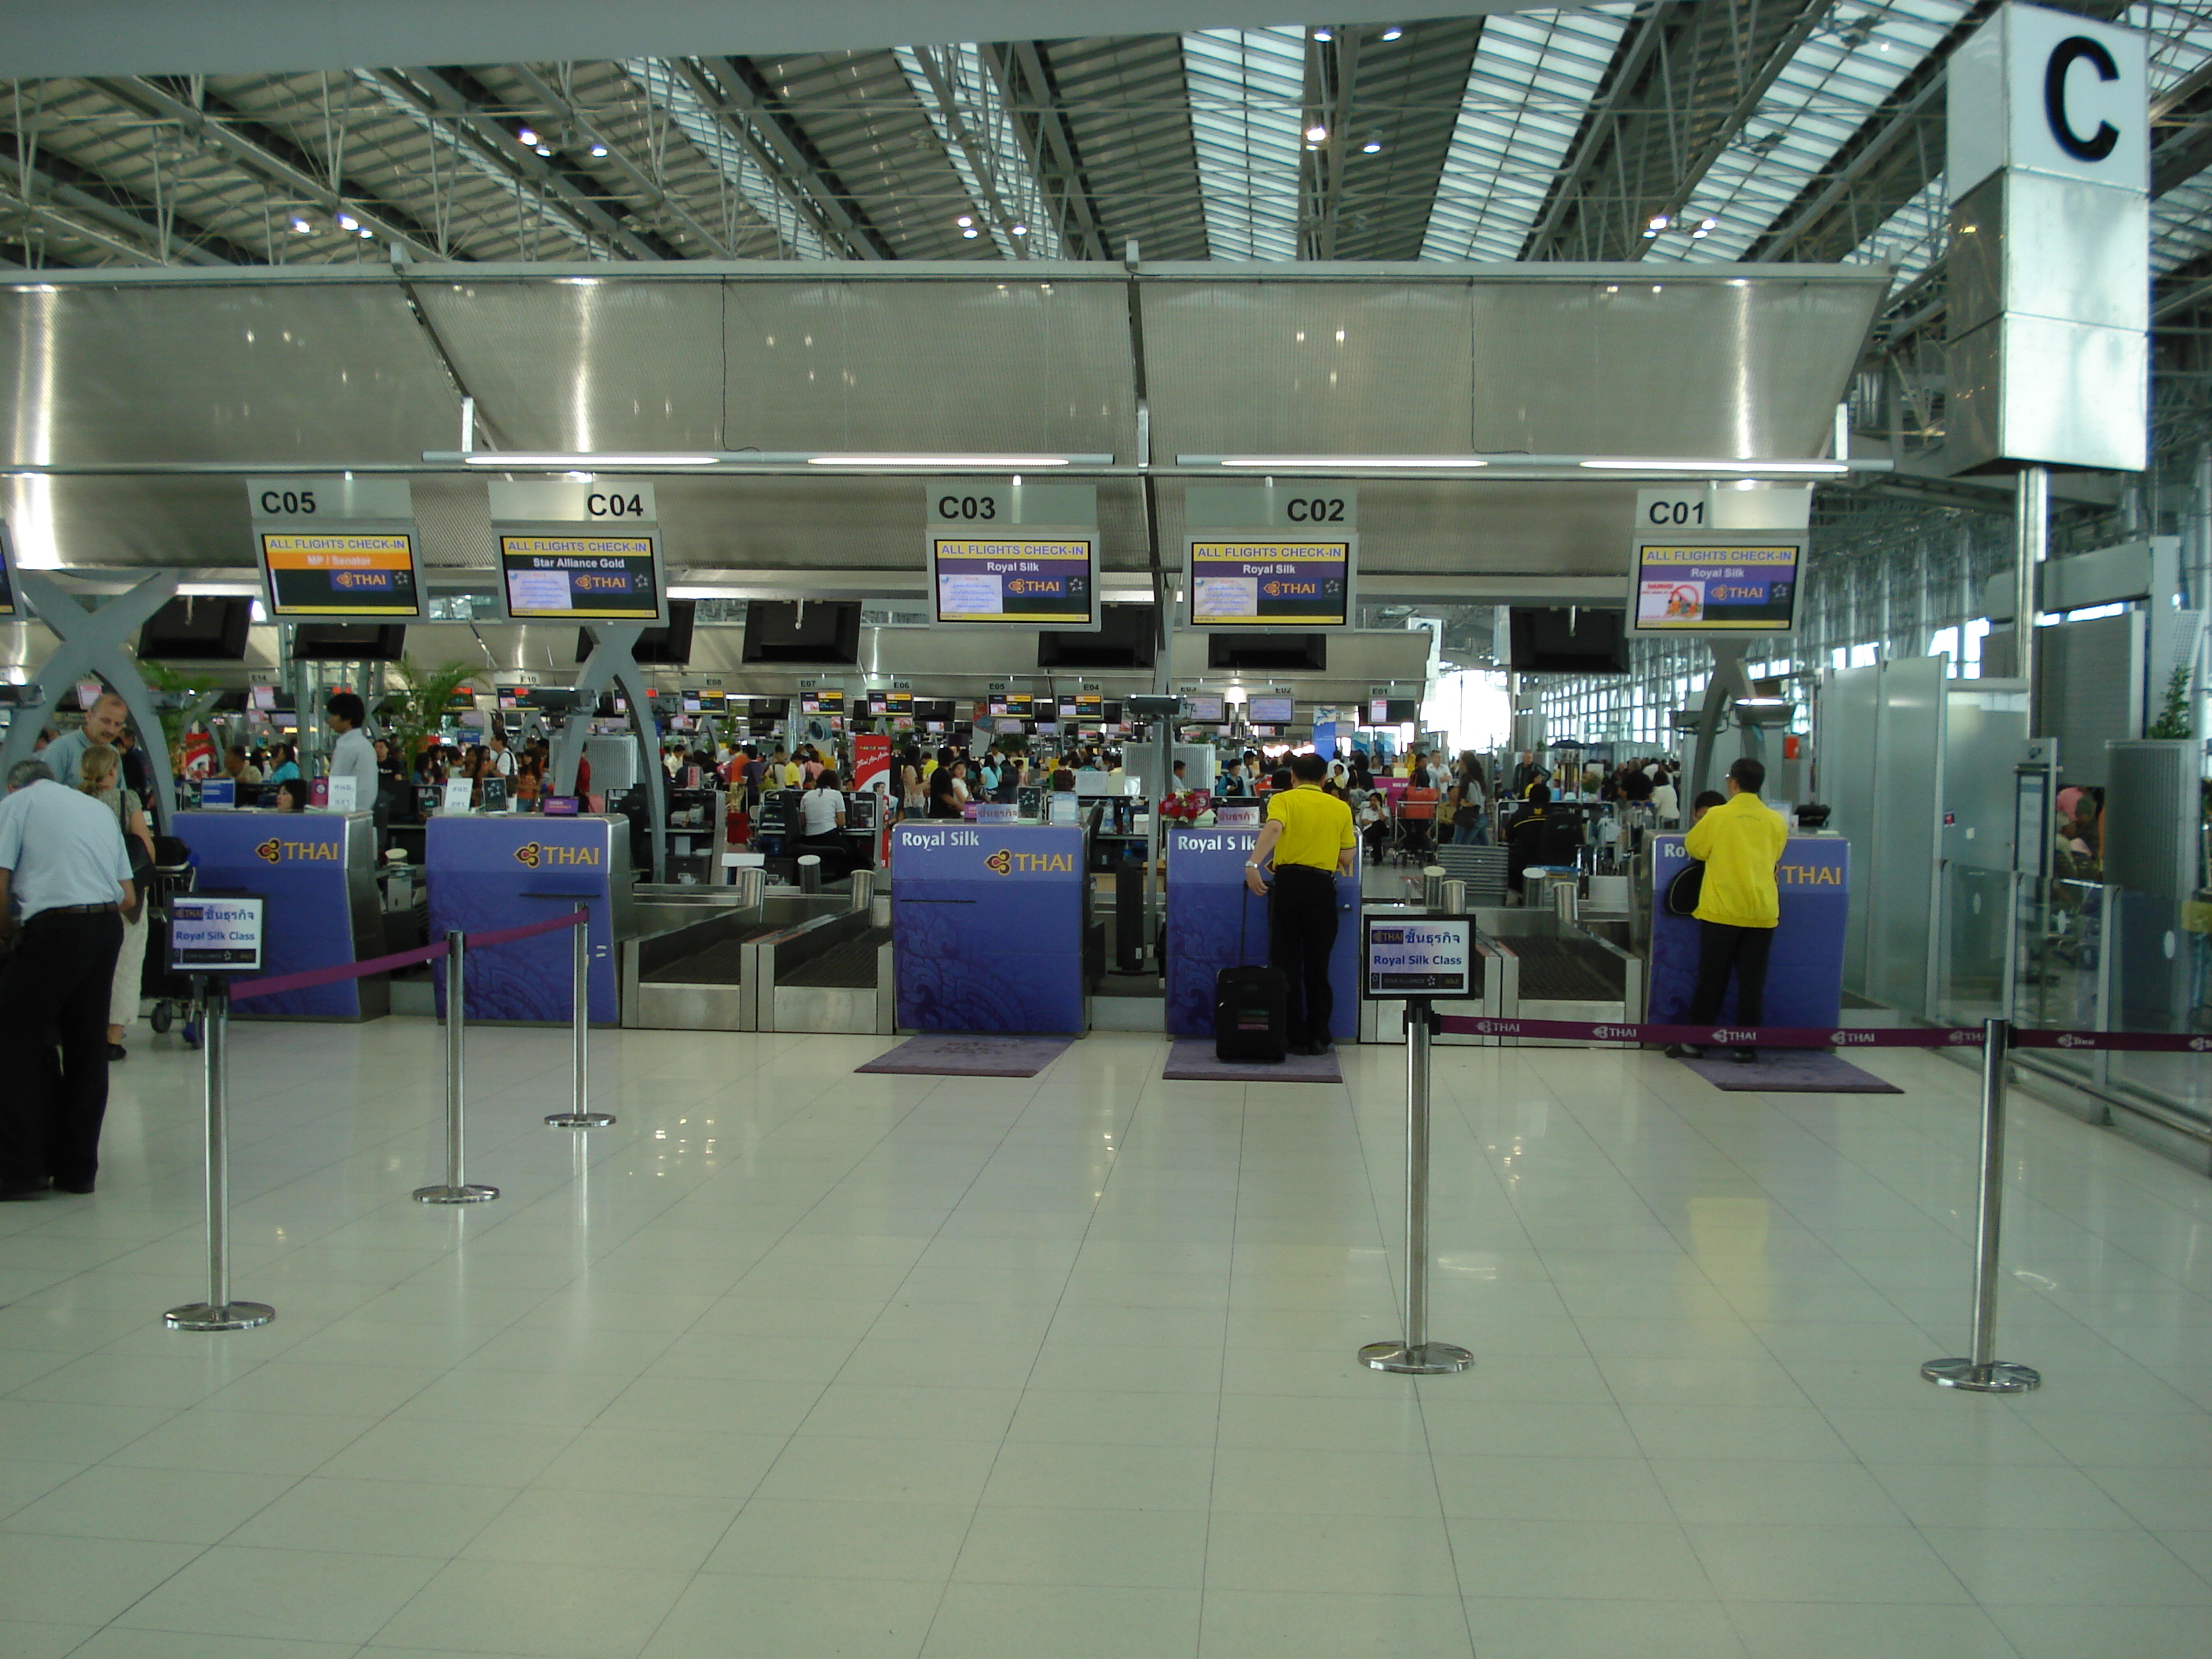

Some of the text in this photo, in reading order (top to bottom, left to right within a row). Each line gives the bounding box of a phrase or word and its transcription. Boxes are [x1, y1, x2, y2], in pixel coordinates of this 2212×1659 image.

[2044, 35, 2121, 163] C
[261, 491, 316, 514] C05
[587, 494, 643, 516] C04
[938, 496, 996, 519] C03
[1287, 498, 1345, 522] C02
[1649, 501, 1705, 524] C01
[270, 539, 405, 549] ALL FLIGHTS CHECK-IN
[508, 541, 647, 552] ALL FLIGHTS CHECK-IN
[942, 545, 1084, 555] ALL FLIGHTS CHECK-IN
[1197, 548, 1341, 558] ALL FLIGHTS CHECK-IN
[1647, 552, 1792, 561] ALL FLIGHTS CHECK-IN
[533, 557, 625, 569] Star Alliance Gold
[986, 562, 1039, 573] Royal Silk
[1242, 565, 1295, 576] Royal Silk
[1691, 567, 1745, 580] Royal Silk
[353, 574, 386, 585] THAI
[592, 577, 626, 588] THAI
[1027, 581, 1060, 592] THAI
[1282, 583, 1316, 593] THAI
[1729, 587, 1763, 598] THAI
[902, 830, 980, 849] Royal Silk
[1178, 835, 1222, 853] Royal
[282, 842, 338, 860] THAI
[543, 846, 600, 865] THAI
[1015, 853, 1073, 872] THAI
[1781, 866, 1842, 885] THAI
[176, 931, 255, 942] Royal Silk Class
[1405, 928, 1460, 947] ชั้นธุรกิจ
[1374, 955, 1462, 966] Royal Silk Class
[1493, 1022, 1520, 1033] THAI
[1609, 1028, 1637, 1038] THAI
[1728, 1031, 1756, 1040] THAI
[1848, 1033, 1875, 1043] THAI
